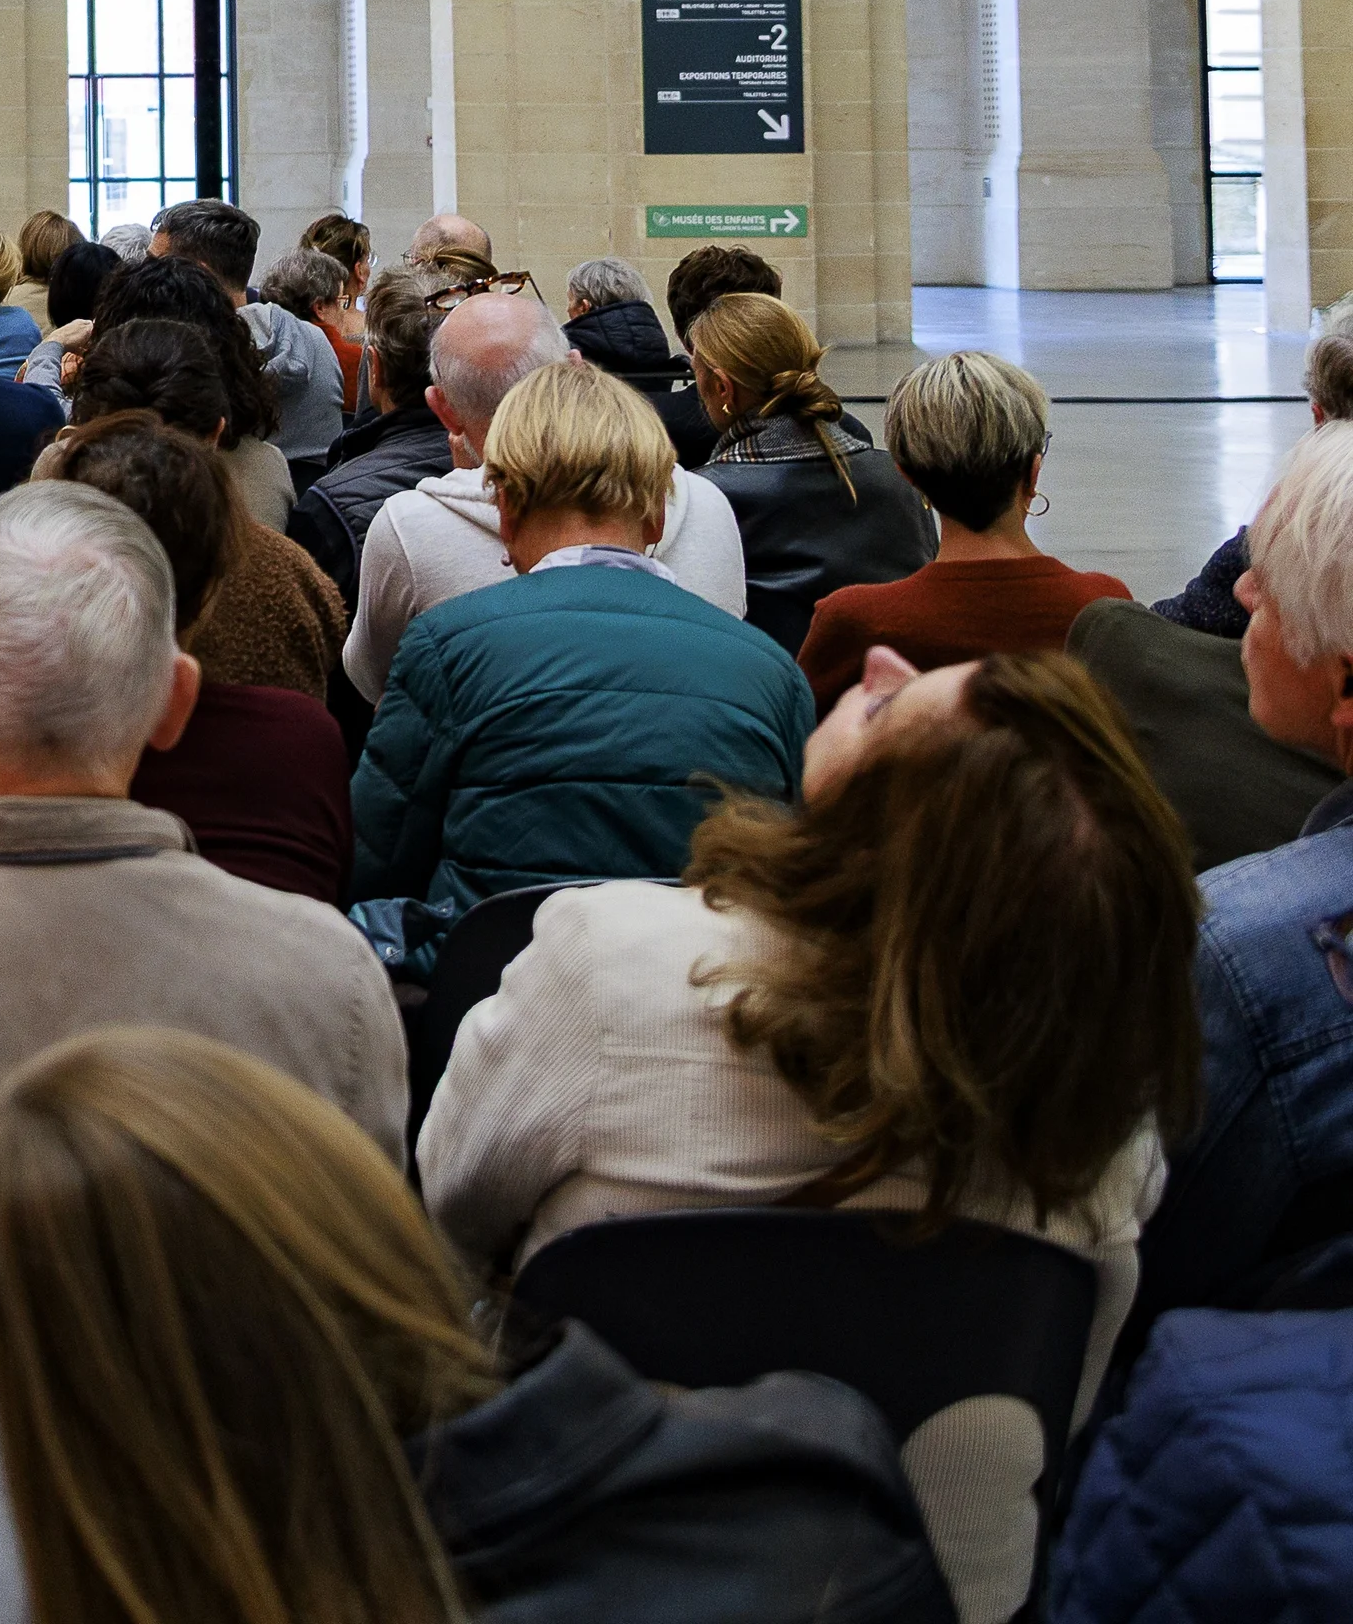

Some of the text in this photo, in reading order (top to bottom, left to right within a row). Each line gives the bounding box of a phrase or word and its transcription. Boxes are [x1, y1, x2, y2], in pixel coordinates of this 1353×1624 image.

[758, 24, 788, 50] -2
[735, 55, 787, 63] AUDITORIUM
[680, 71, 787, 80] EXPOSITIONS TEMPORAIRES
[672, 213, 766, 224] MUSÉE DES ENFANTS
